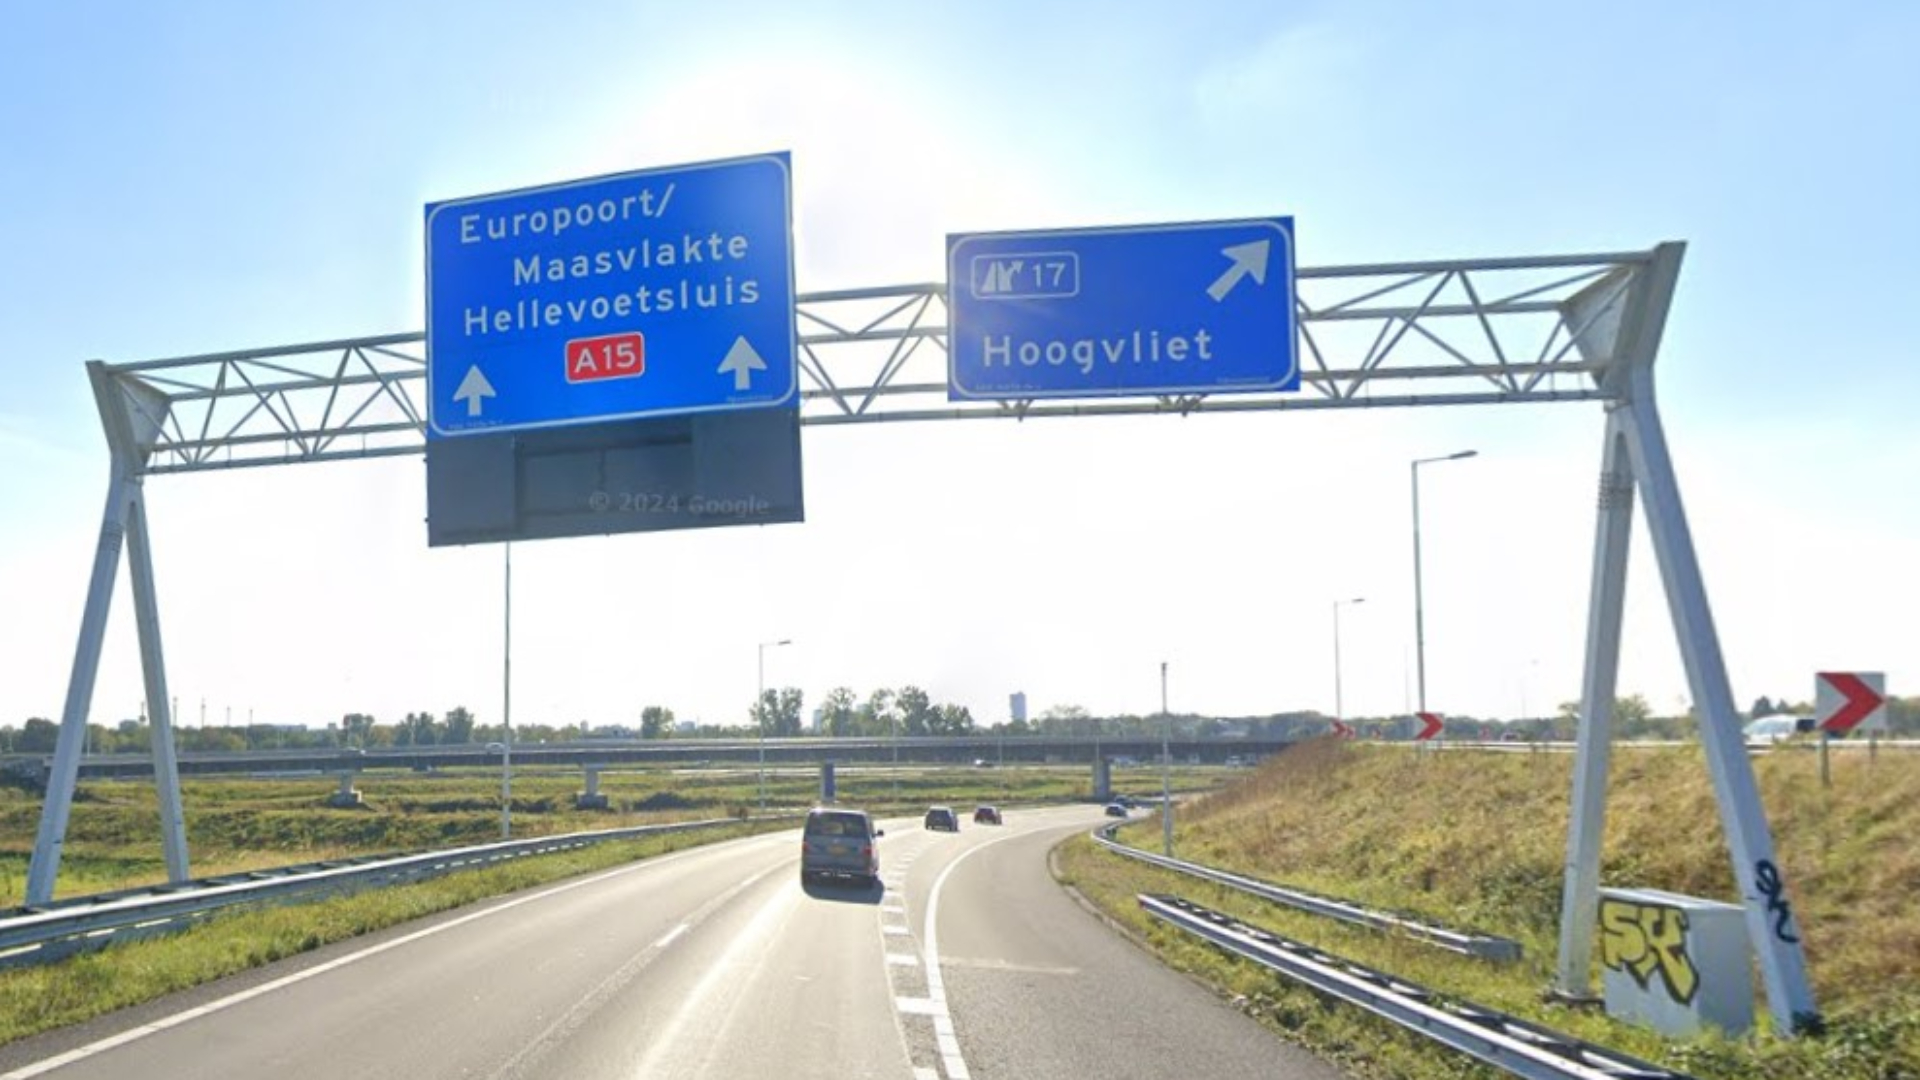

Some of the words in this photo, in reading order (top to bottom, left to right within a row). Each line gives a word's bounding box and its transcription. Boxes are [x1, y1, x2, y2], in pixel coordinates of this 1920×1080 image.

[460, 183, 676, 243] Europoort/
[513, 233, 749, 285] Maasvlakte
[1032, 263, 1066, 287] 17
[464, 276, 760, 336] Hellevoetsluis
[574, 342, 637, 373] A15
[982, 329, 1212, 374] Hoogvliet
